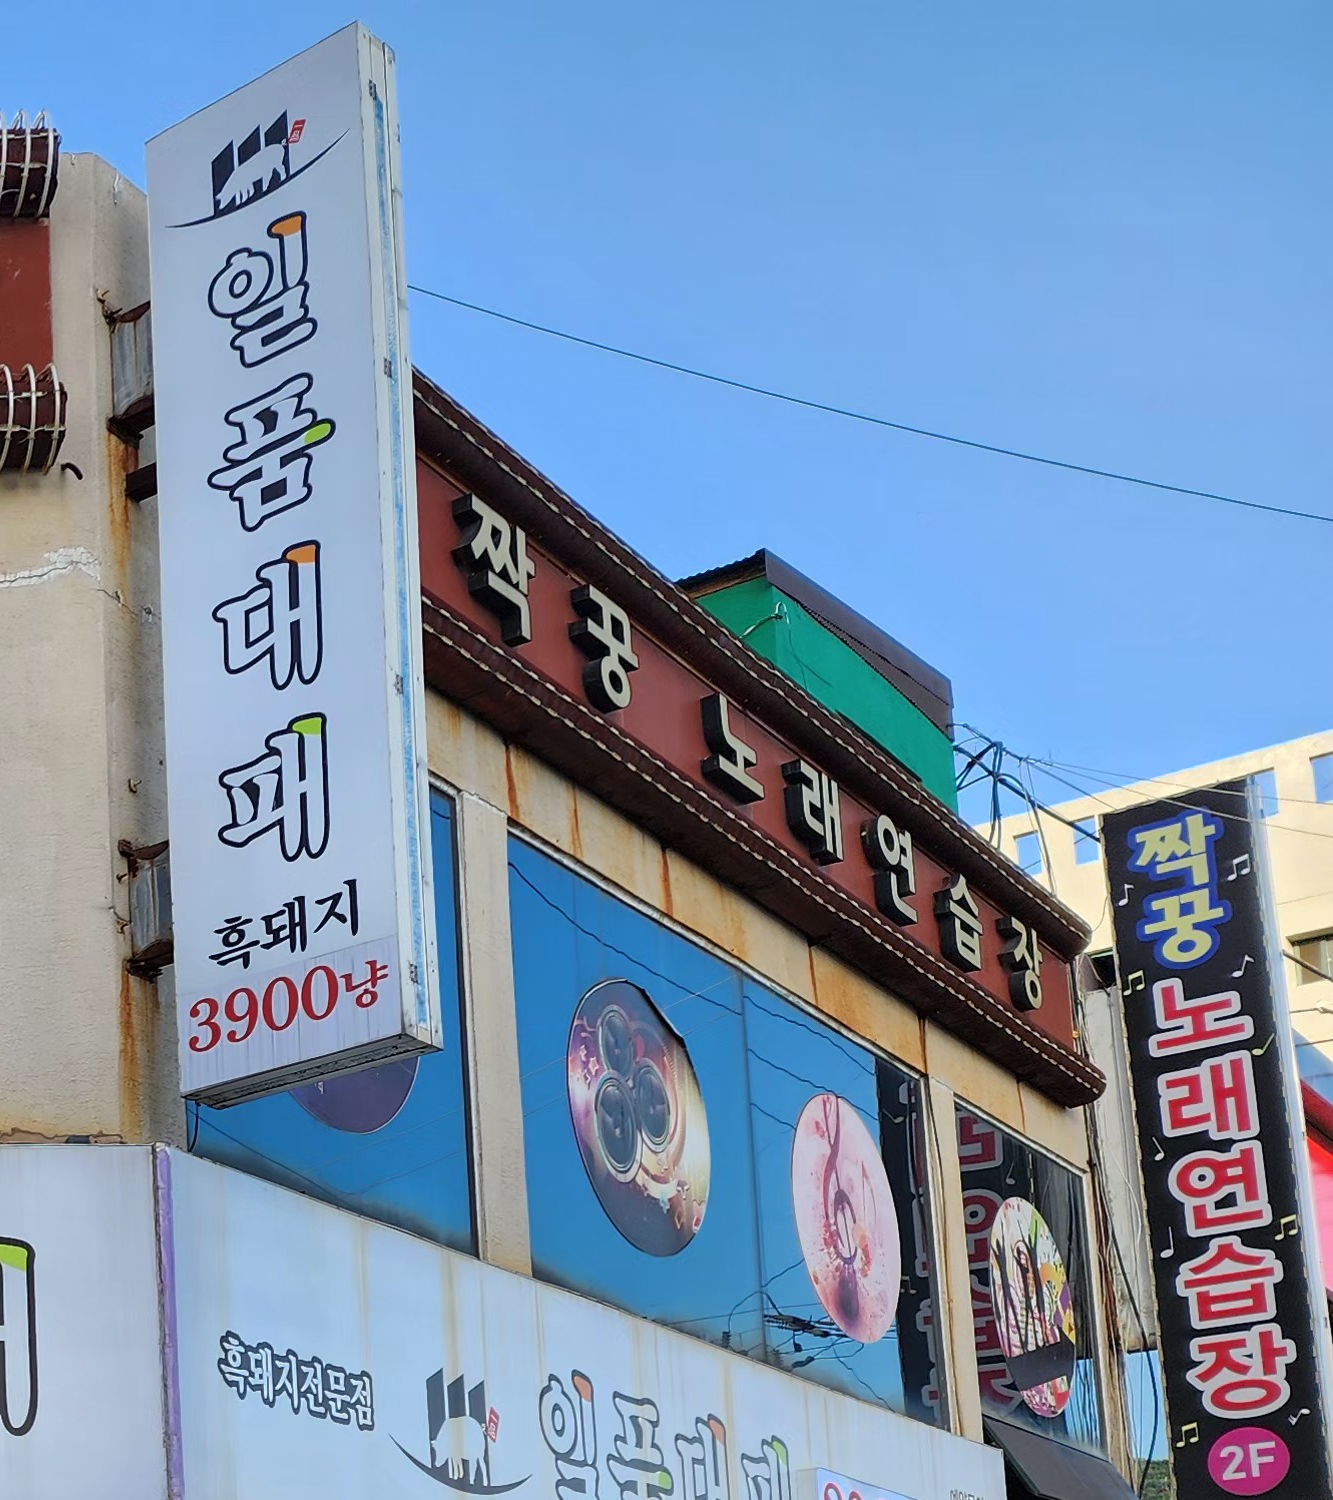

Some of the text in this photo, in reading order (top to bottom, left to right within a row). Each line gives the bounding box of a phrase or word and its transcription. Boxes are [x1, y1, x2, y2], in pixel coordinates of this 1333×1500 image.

[207, 210, 336, 863] 일품대패
[705, 695, 1044, 1012] 노래연습장
[208, 879, 360, 970] 흑돼지
[189, 958, 389, 1053] 3900냥
[1130, 812, 1296, 1420] 짝꿍 노래연습장
[218, 1329, 375, 1432] 흑돼지전문점
[1219, 1441, 1278, 1483] 2F
